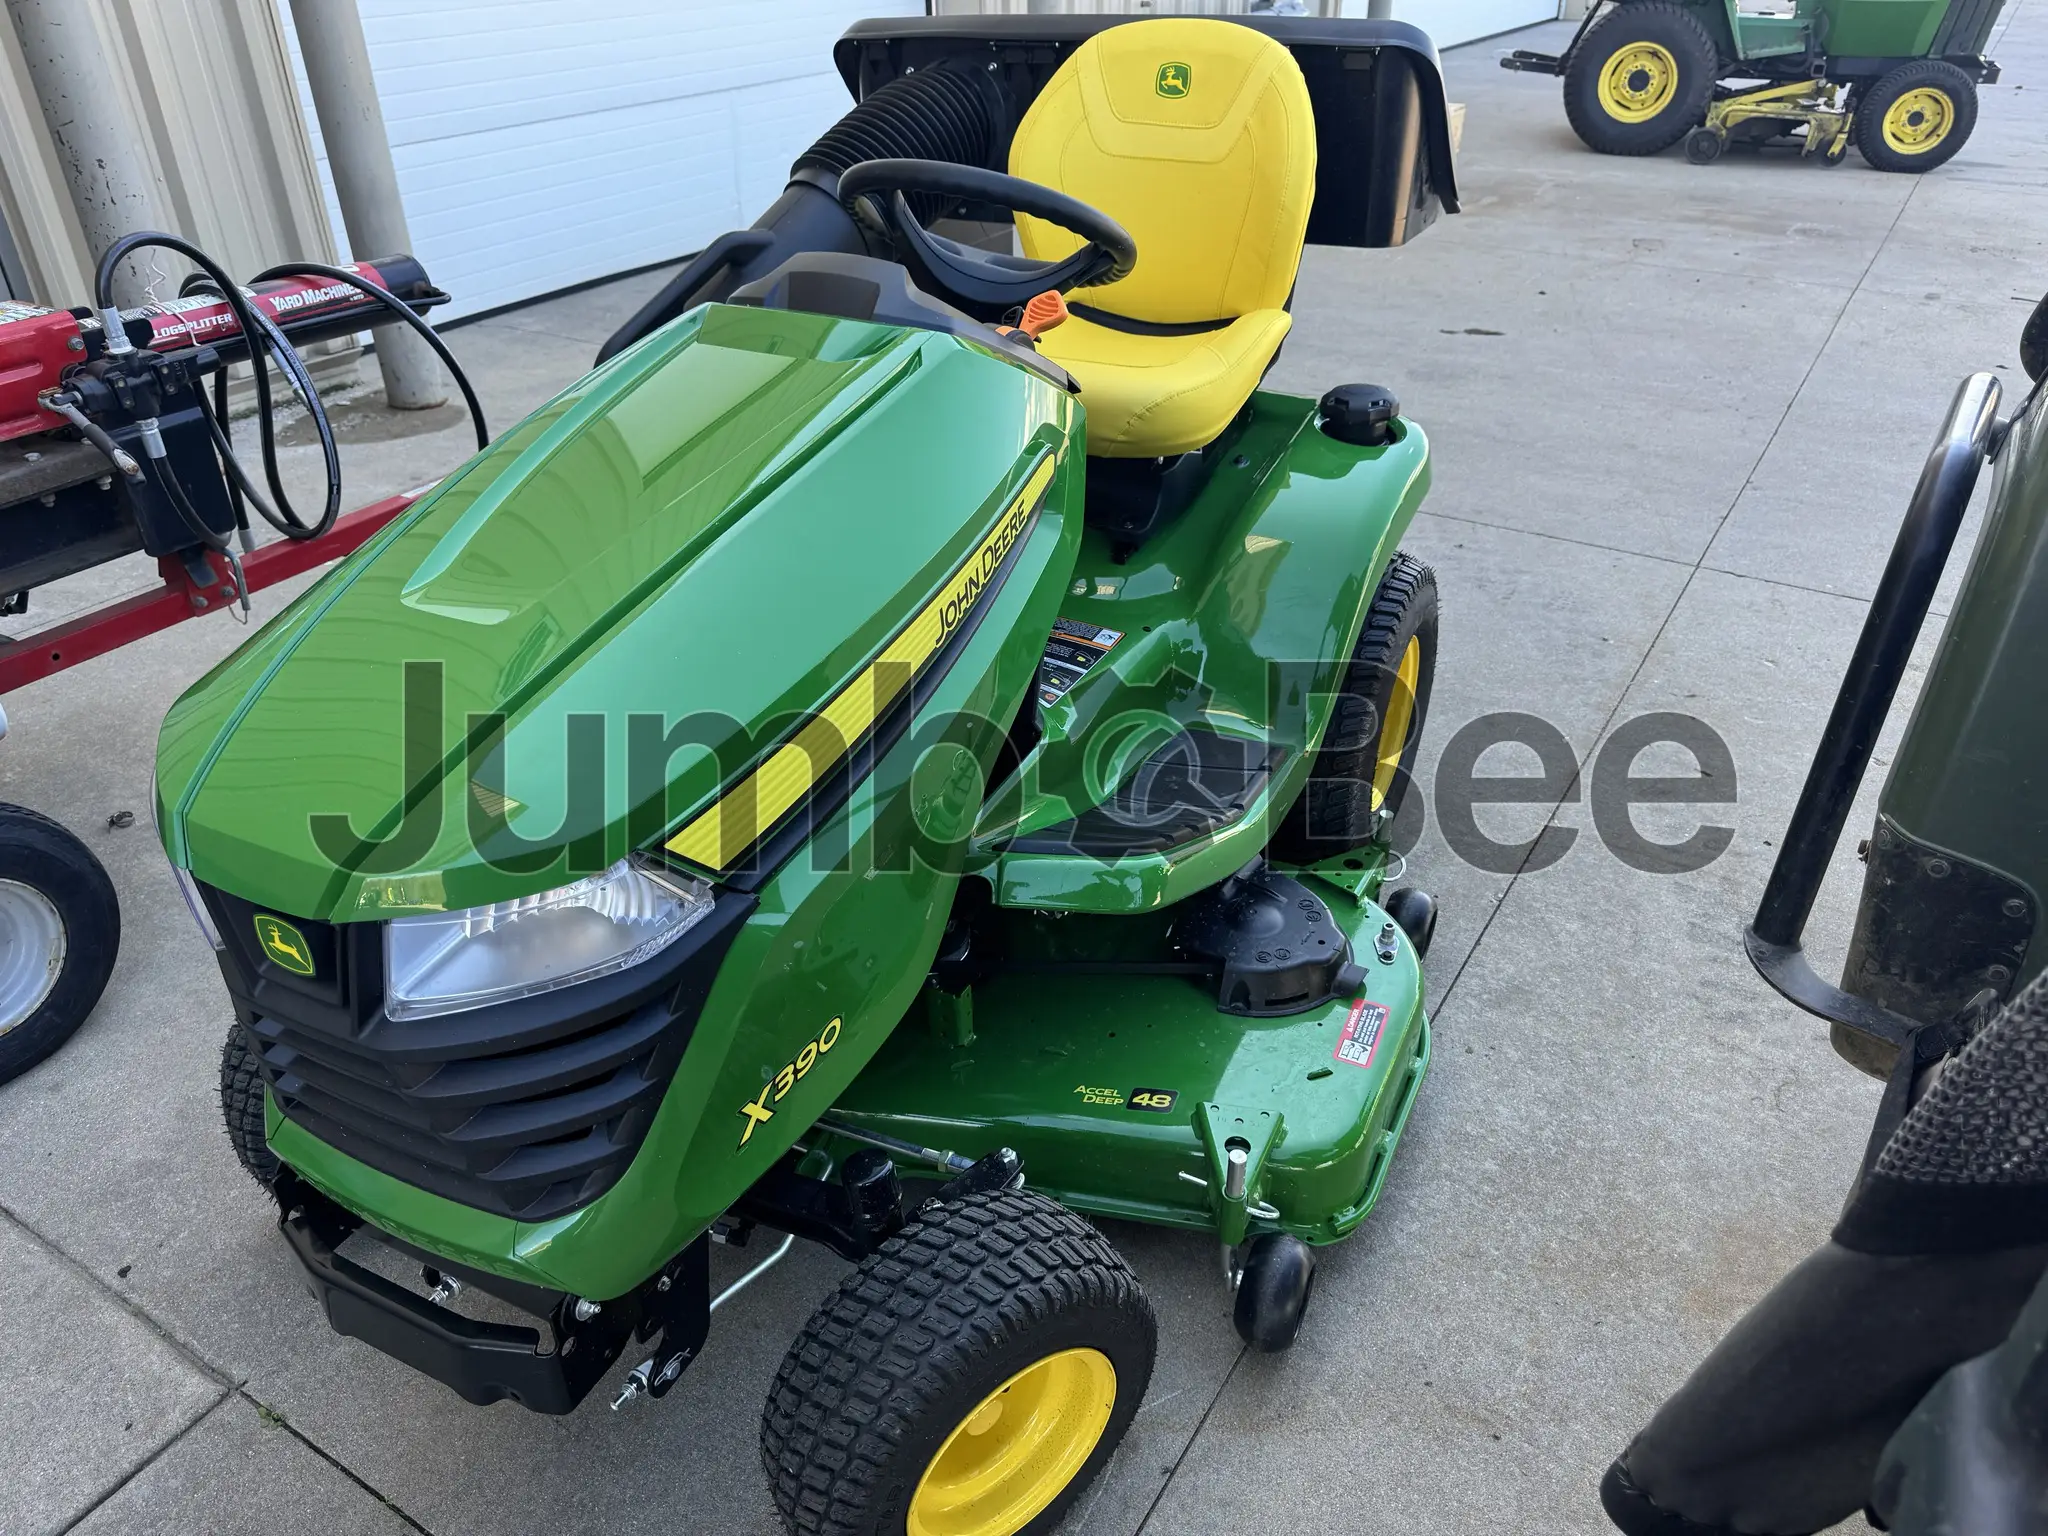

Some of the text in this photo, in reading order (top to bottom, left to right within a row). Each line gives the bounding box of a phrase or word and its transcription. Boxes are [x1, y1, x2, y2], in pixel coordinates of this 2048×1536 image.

[269, 294, 303, 312] YARD
[153, 313, 233, 337] LOGSPLITTER
[935, 498, 1027, 647] JOHN DEERE
[739, 1016, 842, 1148] X390
[1073, 1085, 1172, 1108] ACCEL 48
[1082, 1094, 1124, 1105] DEEP
